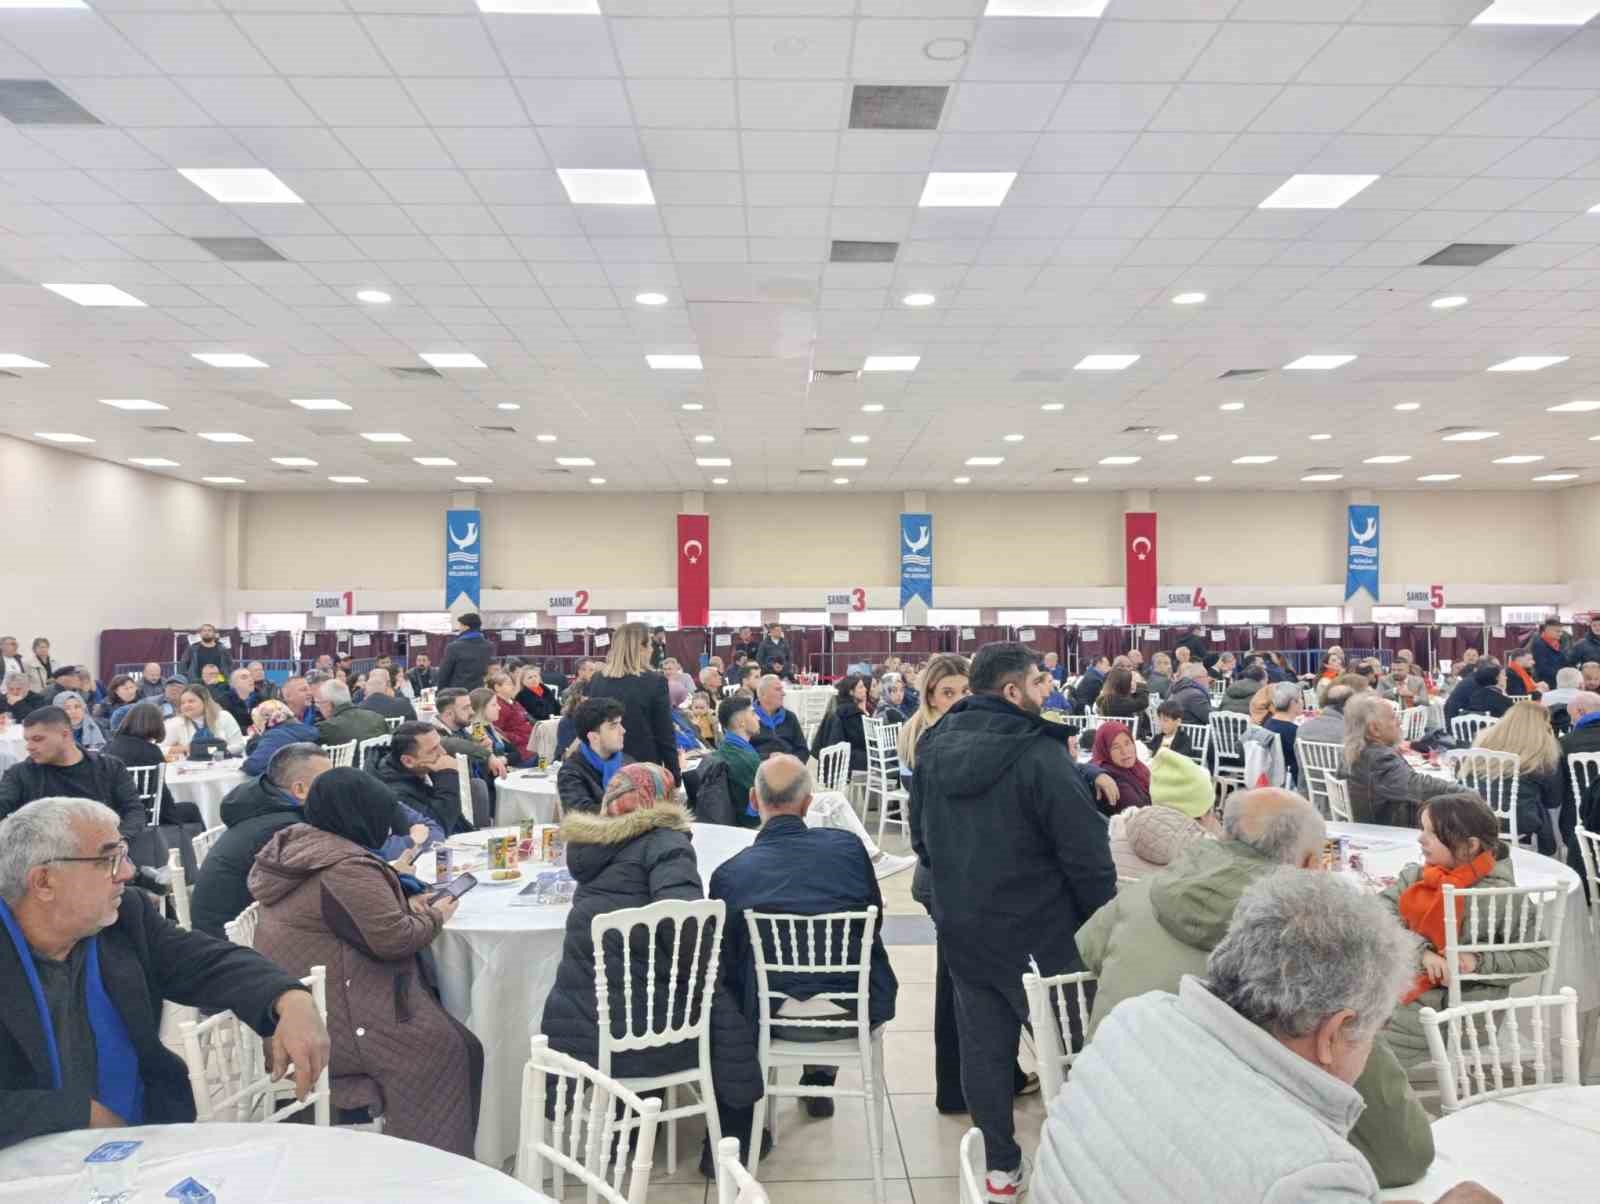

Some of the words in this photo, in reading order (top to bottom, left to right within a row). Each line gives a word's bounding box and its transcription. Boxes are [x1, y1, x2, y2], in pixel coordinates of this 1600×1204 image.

[343, 591, 353, 616] 1
[575, 590, 589, 614] 2
[852, 588, 866, 612] 3
[1193, 587, 1207, 610] 4
[1430, 585, 1444, 609] 5
